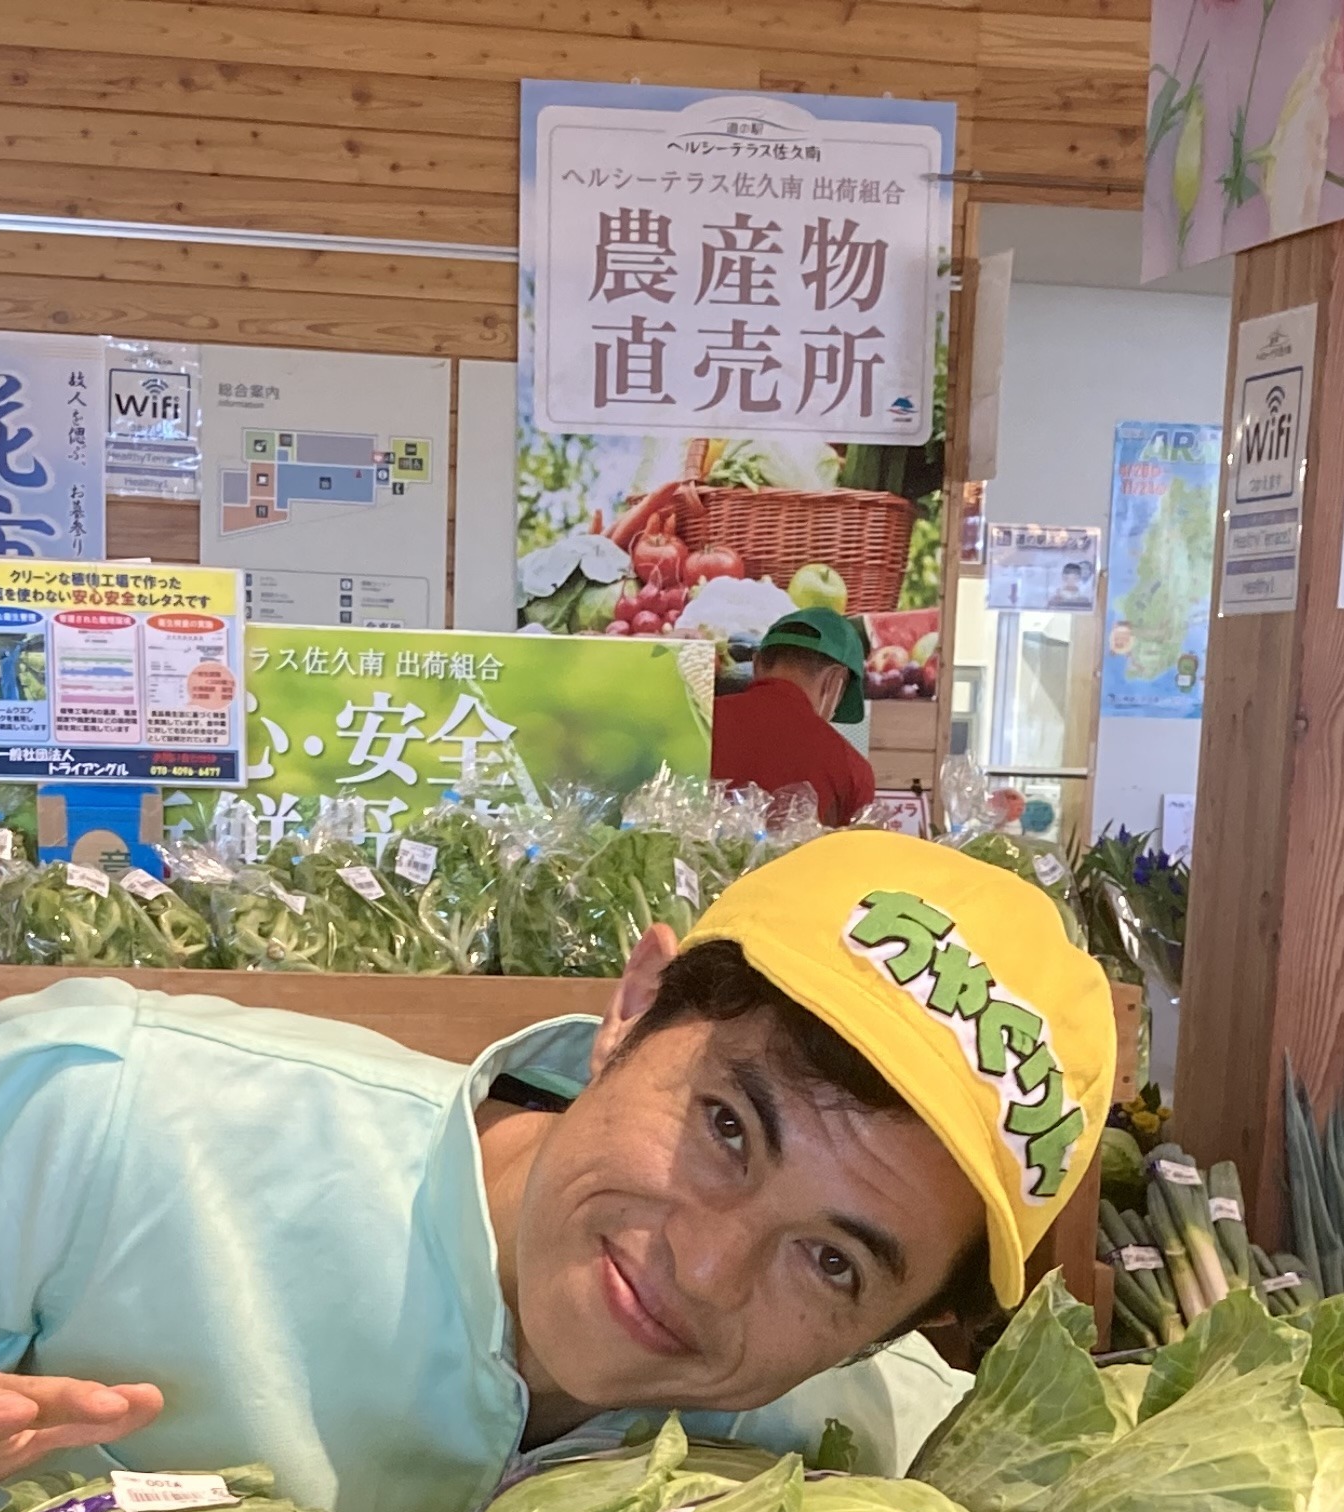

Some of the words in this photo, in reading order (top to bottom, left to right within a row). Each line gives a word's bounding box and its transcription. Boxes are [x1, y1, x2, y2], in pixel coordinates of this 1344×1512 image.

[666, 142, 821, 162] ヘルシーテラス佐久南
[561, 167, 803, 200] ヘルシーテラス佐久南
[812, 175, 906, 206] 出荷組合
[588, 207, 890, 314] 農産物
[591, 314, 887, 418] 直売所
[114, 392, 180, 420] Wifi
[217, 382, 281, 401] 総合案内
[1245, 413, 1293, 465] Wifi
[9, 568, 182, 591] クリーンな植物工場で作った
[395, 653, 505, 682] 出荷組合
[47, 762, 129, 777] トライアングル
[848, 889, 1086, 1198] ちゃぐりん
